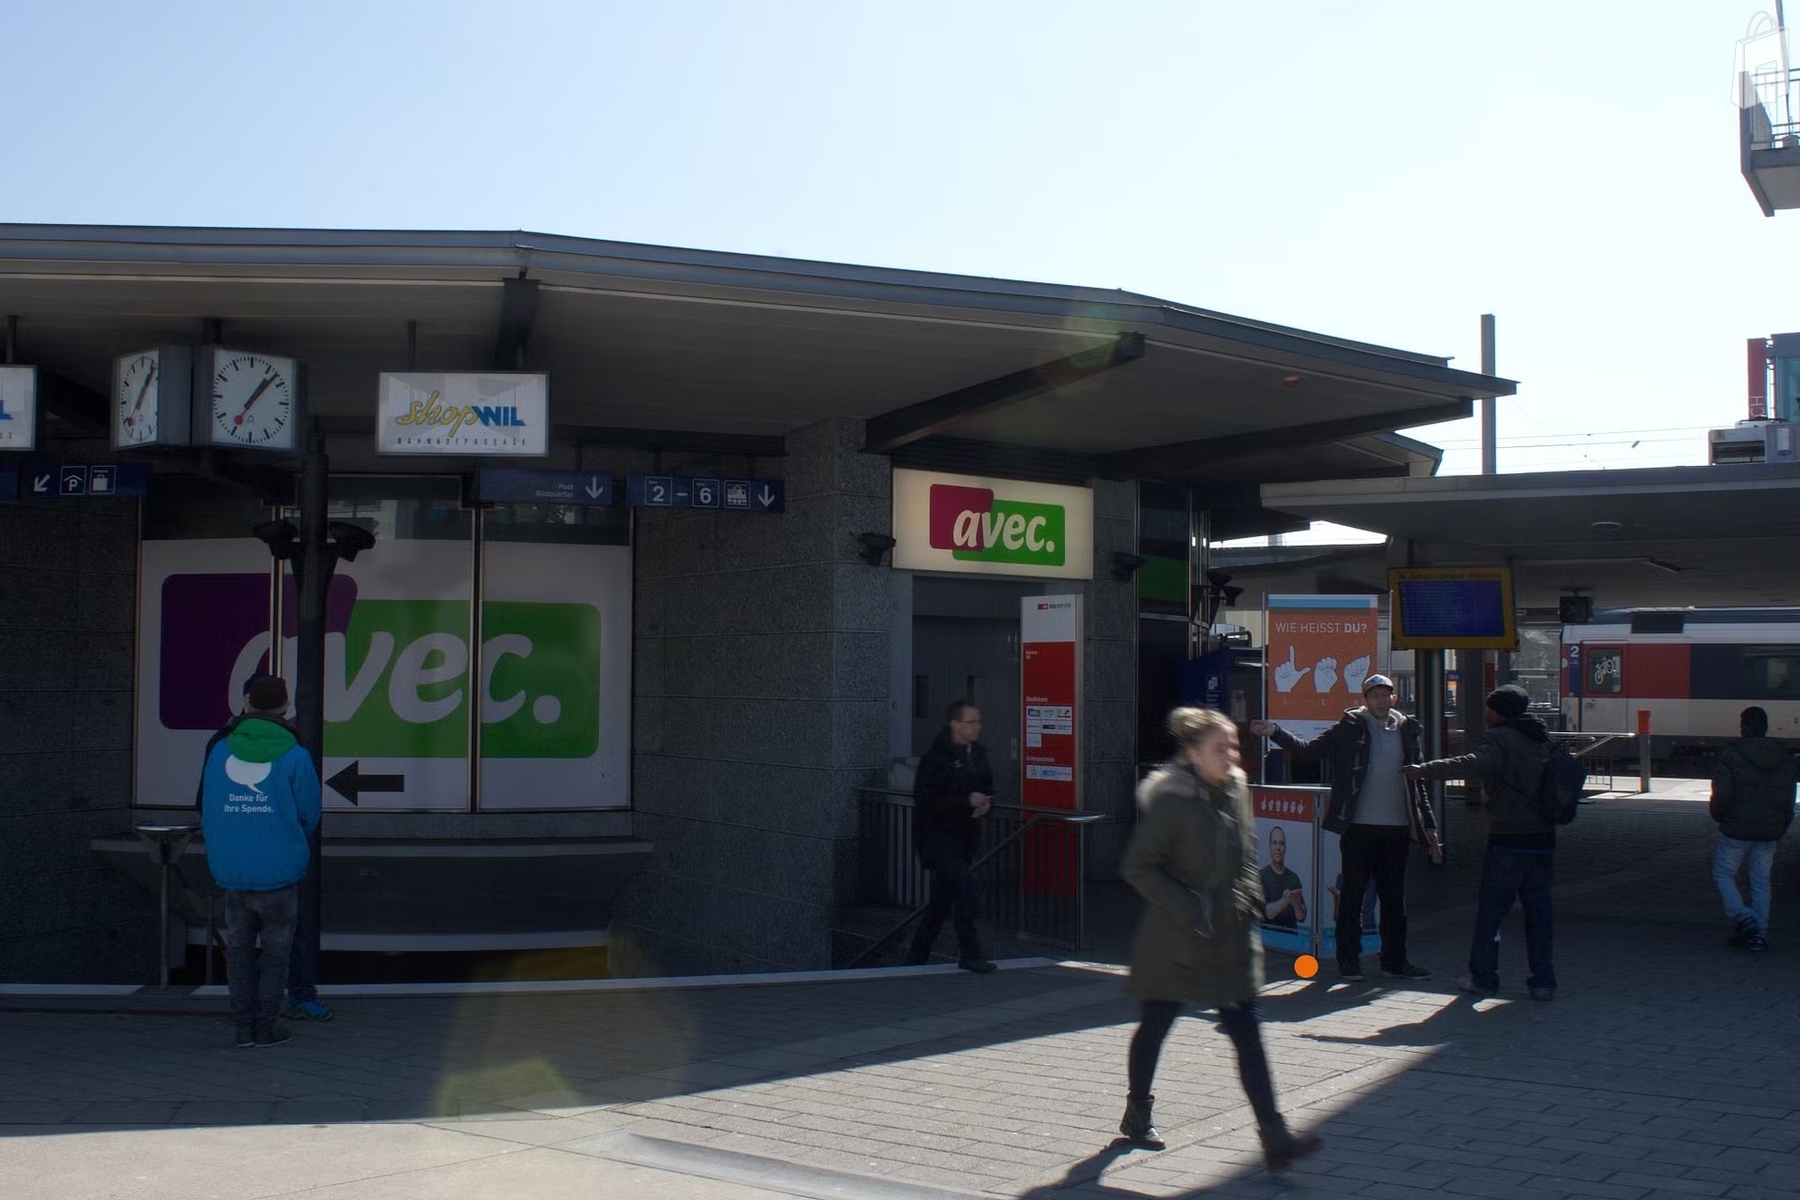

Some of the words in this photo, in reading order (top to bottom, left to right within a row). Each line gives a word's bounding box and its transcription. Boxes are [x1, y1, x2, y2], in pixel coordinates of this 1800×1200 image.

[397, 437, 526, 446] BAHNHOFPASSAGE
[558, 483, 574, 491] Post
[652, 485, 665, 502] 2
[699, 487, 712, 504] 6
[953, 509, 1055, 553] avec.
[1275, 622, 1297, 633] WIE
[1300, 622, 1341, 634] HEISST
[1344, 623, 1367, 633] DU?
[1569, 645, 1580, 658] 2
[228, 793, 254, 802] Danke
[255, 793, 269, 802] für
[224, 804, 240, 813] Ihre
[241, 804, 275, 815] Spende.
